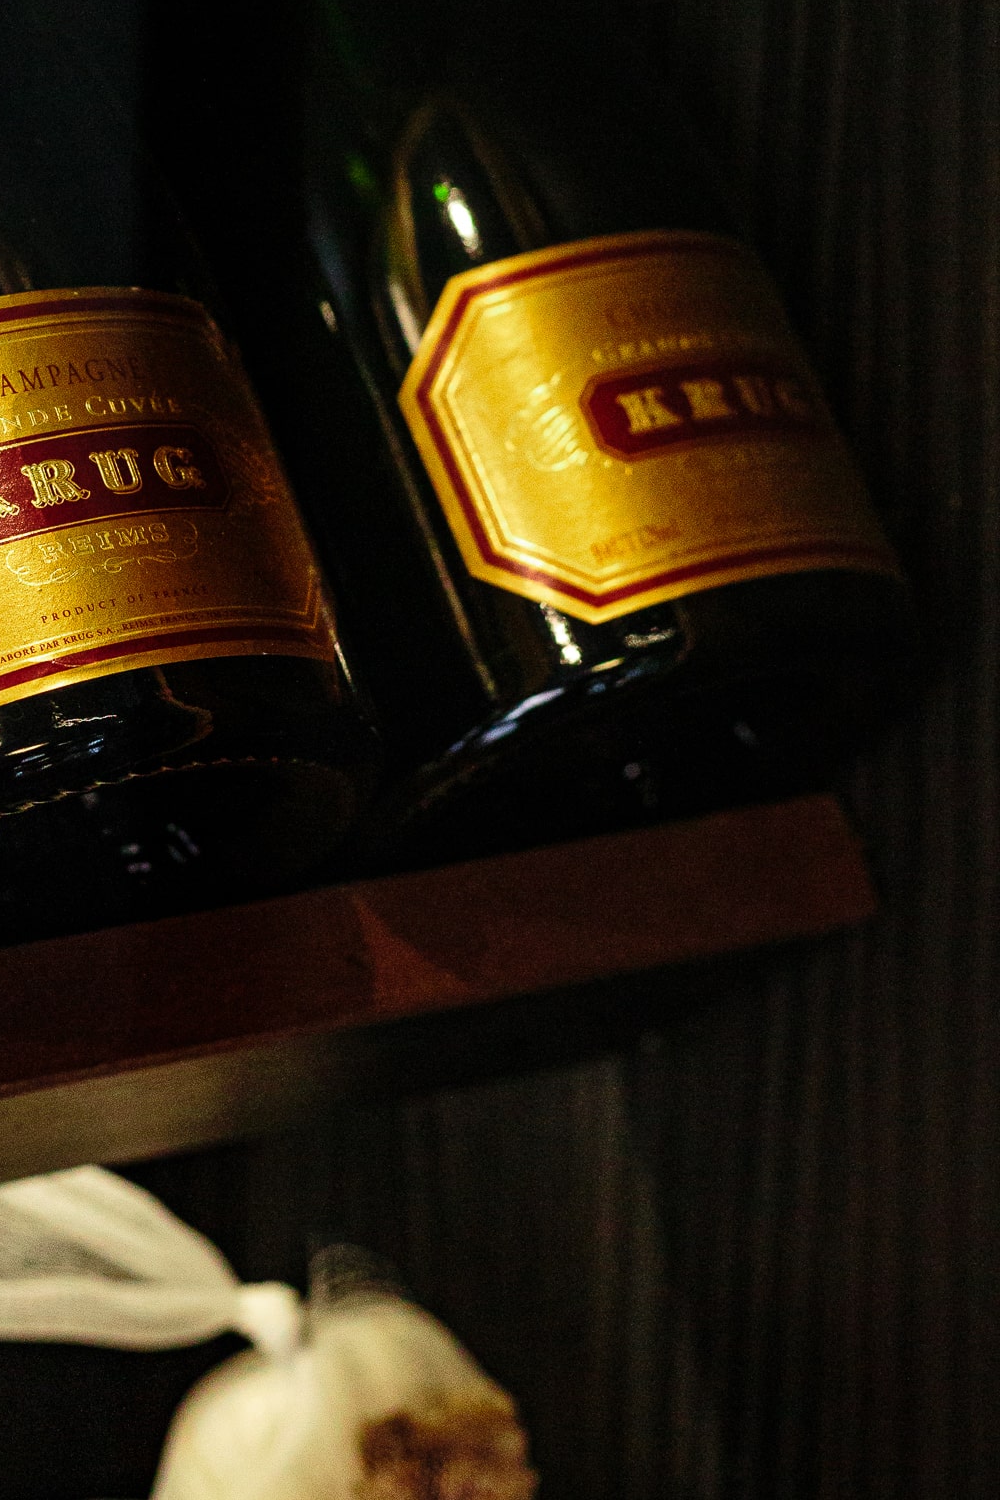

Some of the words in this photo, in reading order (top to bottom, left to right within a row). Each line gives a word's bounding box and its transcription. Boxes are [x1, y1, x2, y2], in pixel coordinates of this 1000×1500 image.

[37, 522, 171, 565] REIMS
[40, 597, 118, 624] PRODUCT
[63, 631, 95, 645] KRUG
